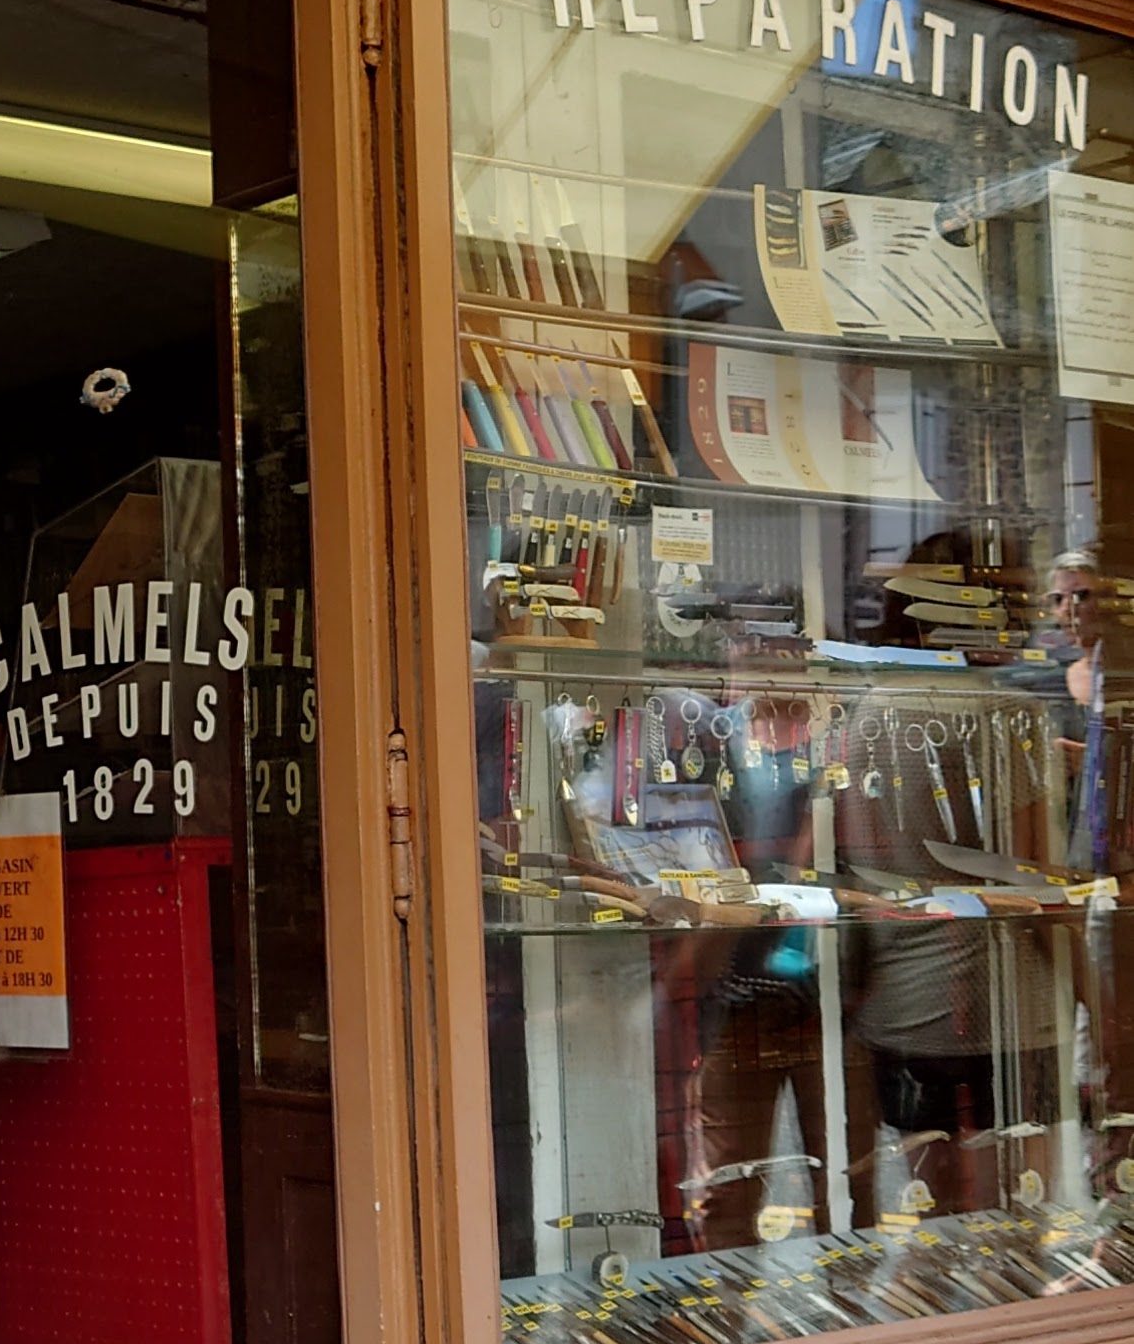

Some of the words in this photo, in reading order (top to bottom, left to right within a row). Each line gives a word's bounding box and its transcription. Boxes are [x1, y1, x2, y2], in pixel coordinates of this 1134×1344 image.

[7, 681, 218, 761] DEPUIS
[63, 758, 196, 822] 1829
[4, 926, 27, 942] 12H
[31, 926, 45, 941] 30
[6, 949, 24, 964] DE
[13, 972, 36, 987] 18H
[40, 972, 53, 987] 30
